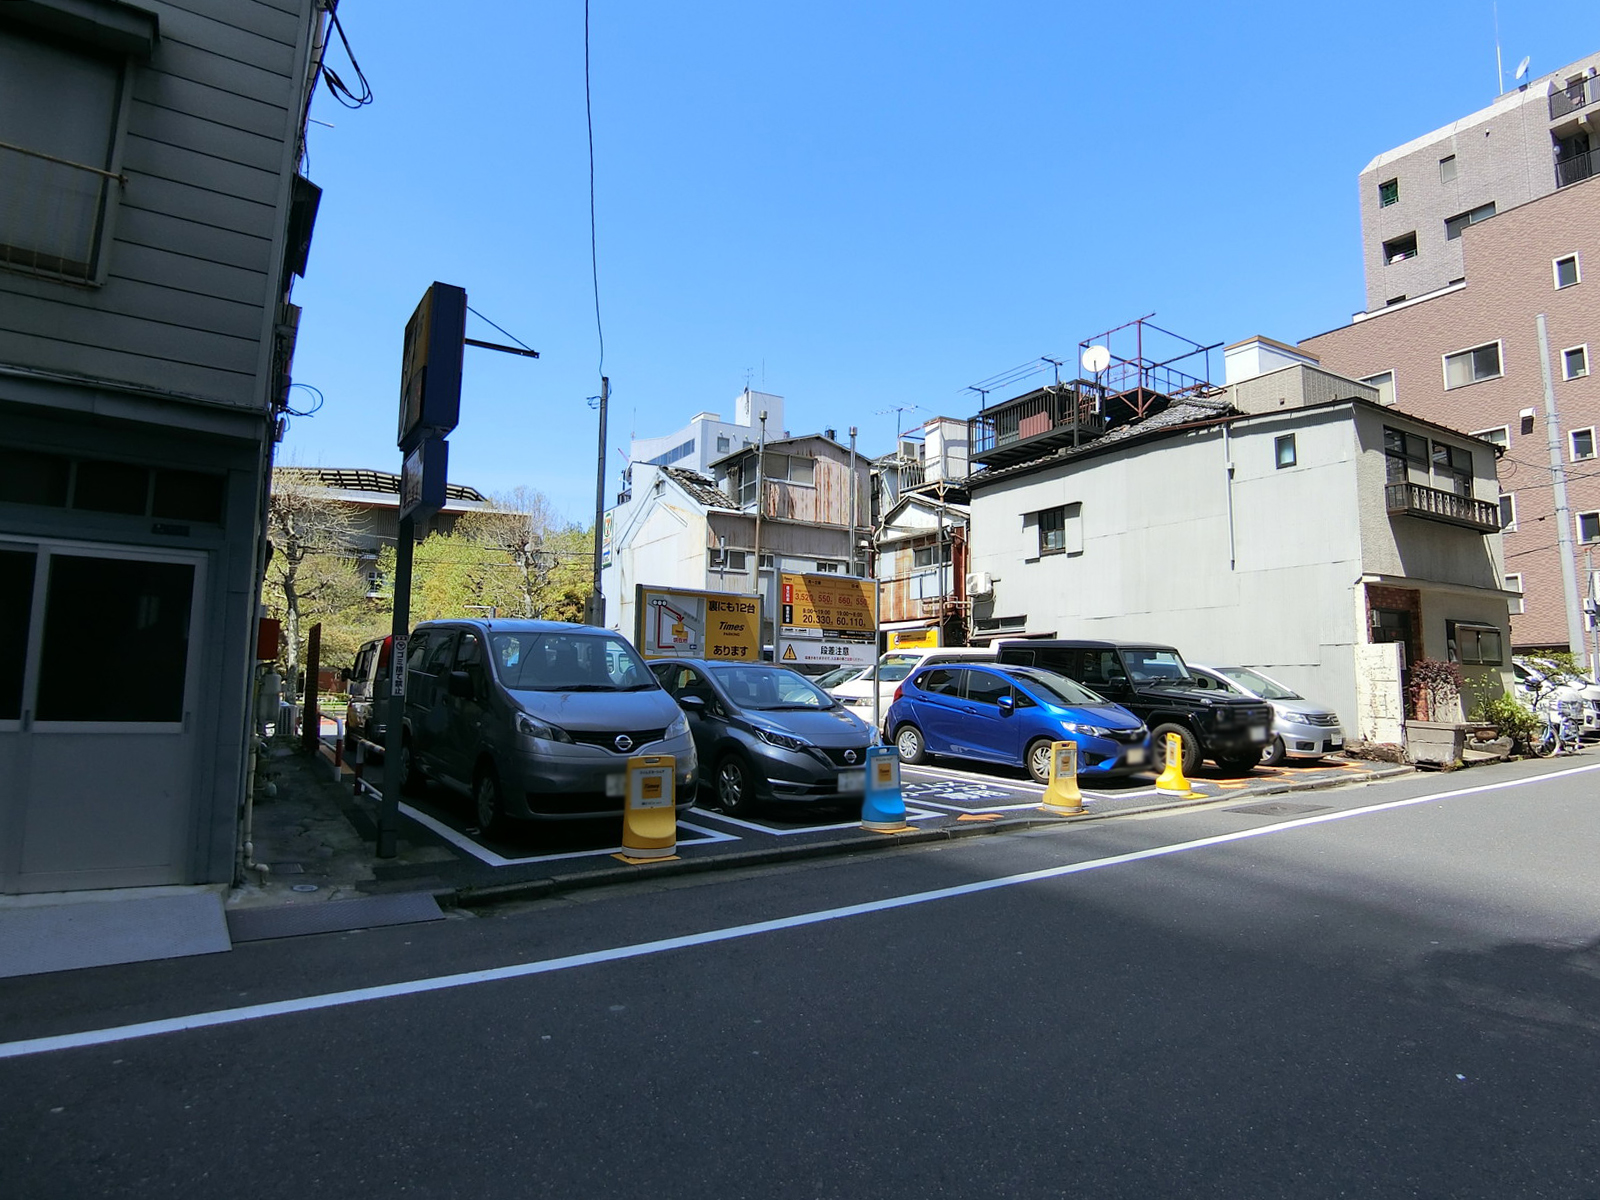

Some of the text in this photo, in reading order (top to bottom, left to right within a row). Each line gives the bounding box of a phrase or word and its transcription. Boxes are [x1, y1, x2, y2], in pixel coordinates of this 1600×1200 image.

[708, 600, 756, 614] 裏にも12台
[719, 621, 745, 631] Times
[713, 645, 748, 657] あります
[820, 646, 850, 656] 段差注意
[394, 652, 404, 695] ゴミ捨て禁止
